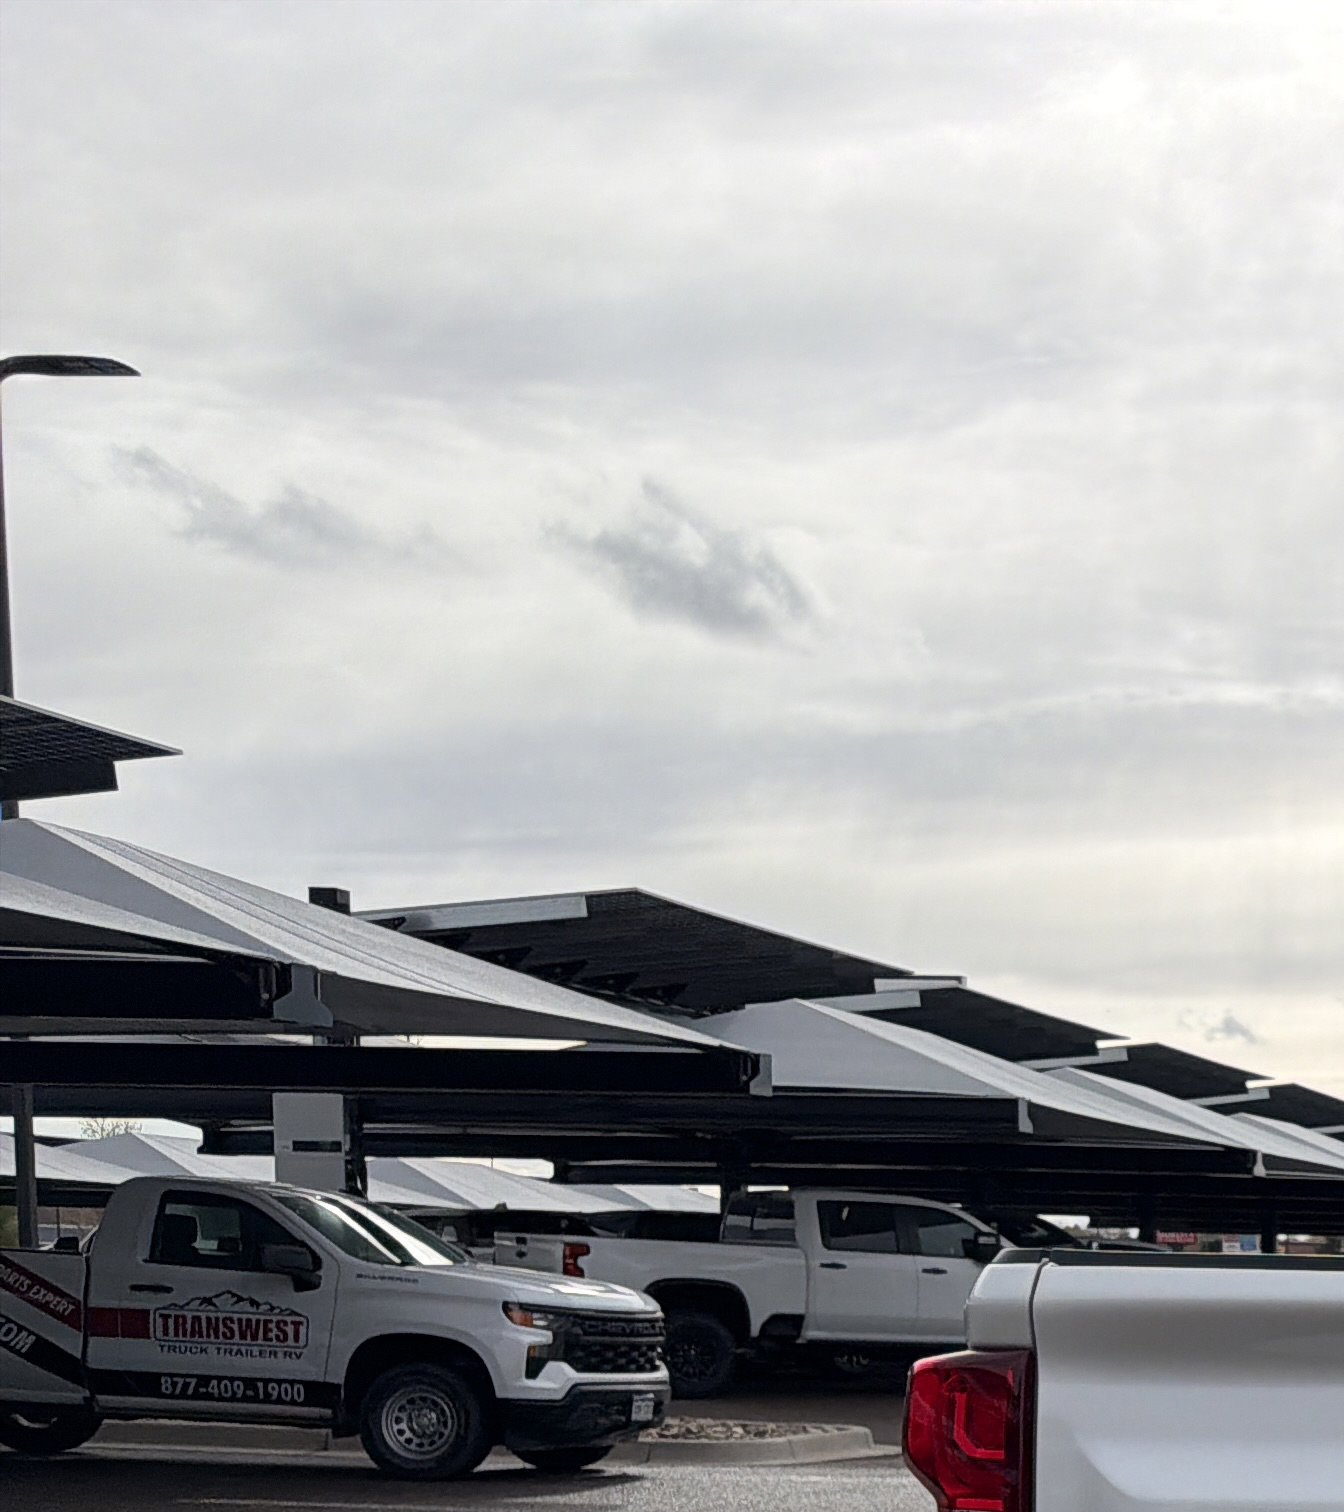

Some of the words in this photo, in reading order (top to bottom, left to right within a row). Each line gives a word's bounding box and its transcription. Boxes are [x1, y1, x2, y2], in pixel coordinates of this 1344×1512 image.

[29, 1285, 76, 1316] EXPERT
[158, 1314, 304, 1344] TRANSWEST
[159, 1344, 209, 1356] TRUCK
[216, 1347, 278, 1360] TRAILER
[283, 1350, 304, 1361] RV
[161, 1375, 305, 1403] 877-409-1900
